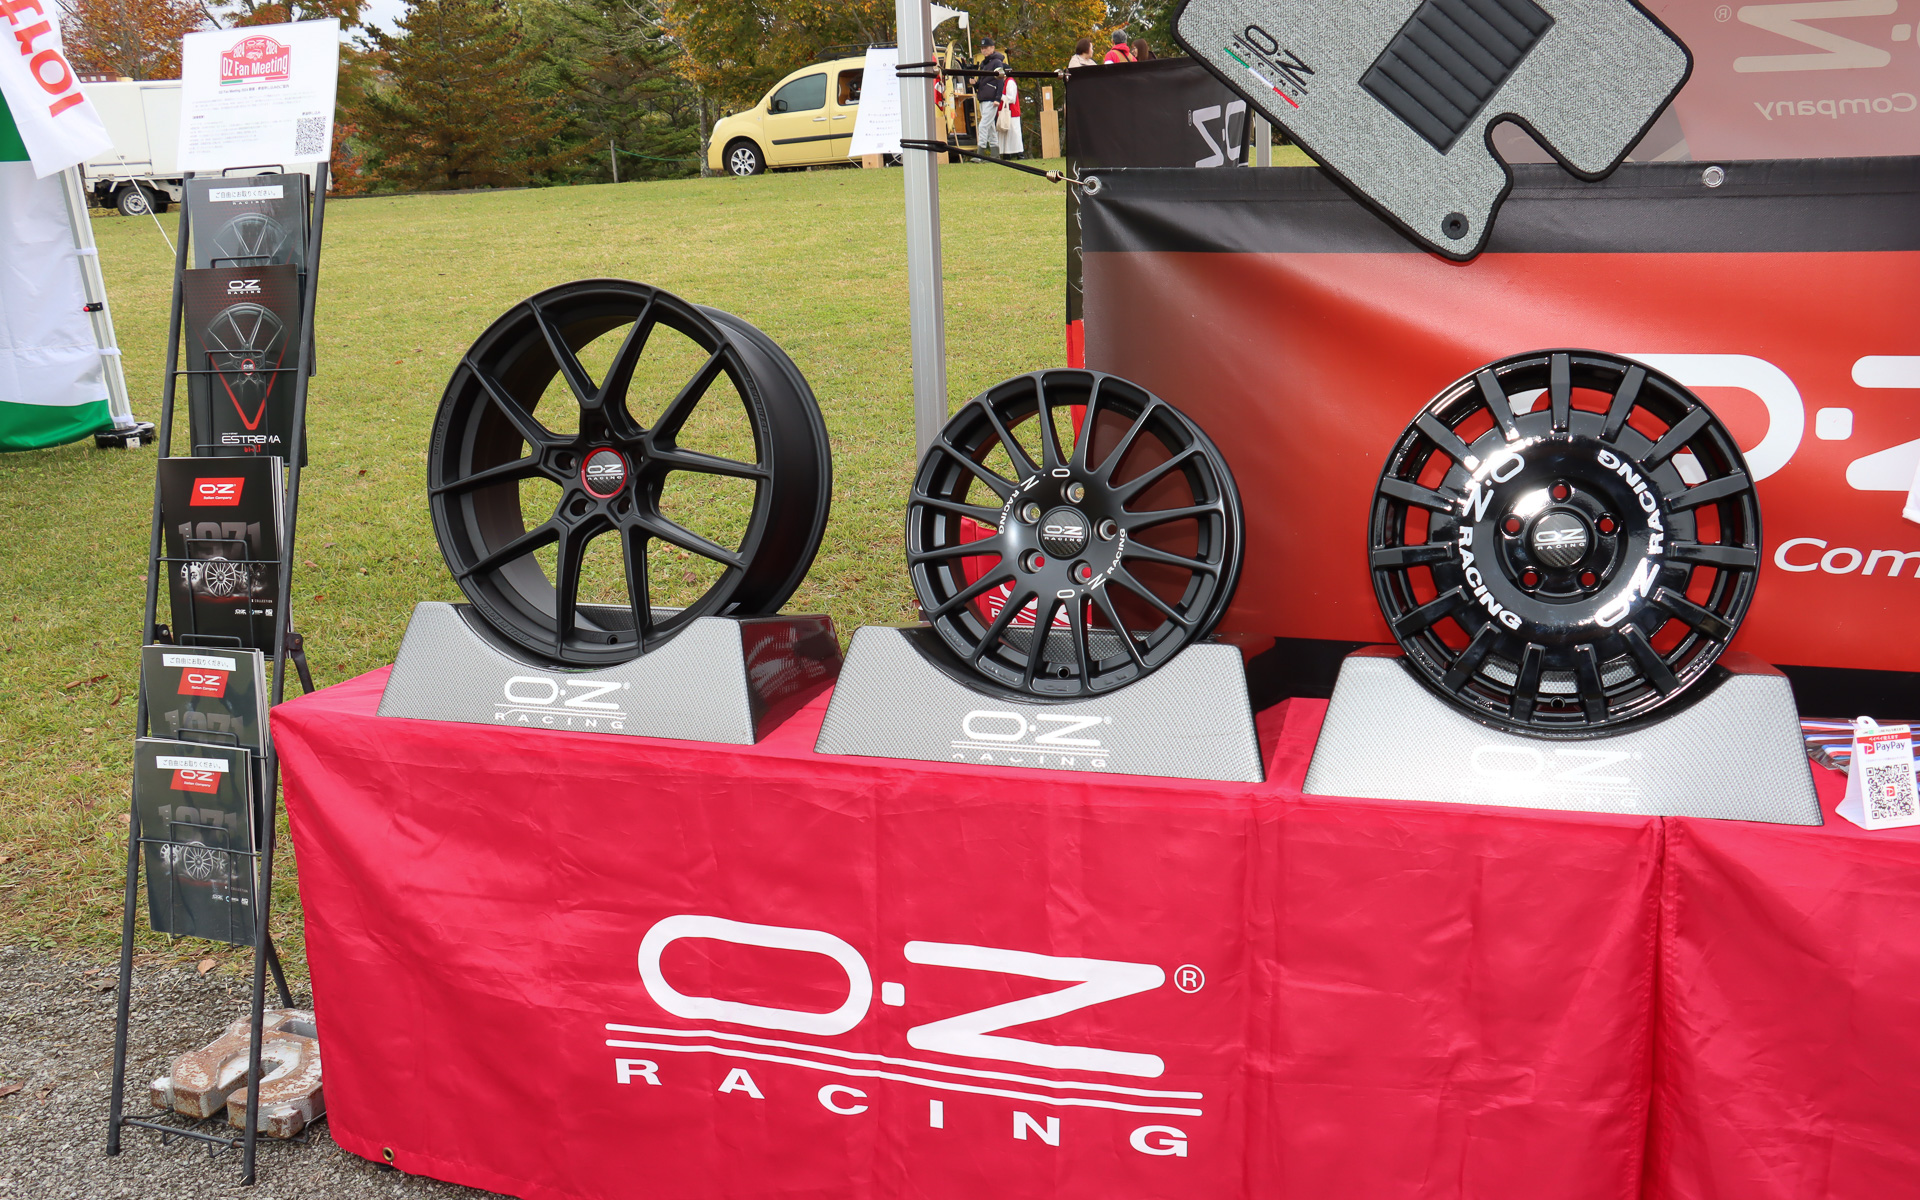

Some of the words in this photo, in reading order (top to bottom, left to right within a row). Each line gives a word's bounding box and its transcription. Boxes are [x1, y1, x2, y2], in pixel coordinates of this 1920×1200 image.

[266, 40, 278, 55] 2024
[223, 57, 233, 77] OZ
[234, 61, 250, 76] Fan
[251, 54, 289, 75] Meeting
[1233, 42, 1299, 97] RACING
[221, 434, 282, 444] ESTREMA
[998, 489, 1020, 535] RACING
[1597, 449, 1665, 555] RACING
[1106, 528, 1126, 576] RACING
[1538, 542, 1585, 551] RACING
[1458, 525, 1523, 631] RACING
[494, 712, 624, 730] RACING
[1875, 741, 1906, 752] PayPay
[614, 1058, 1189, 1158] RACING
